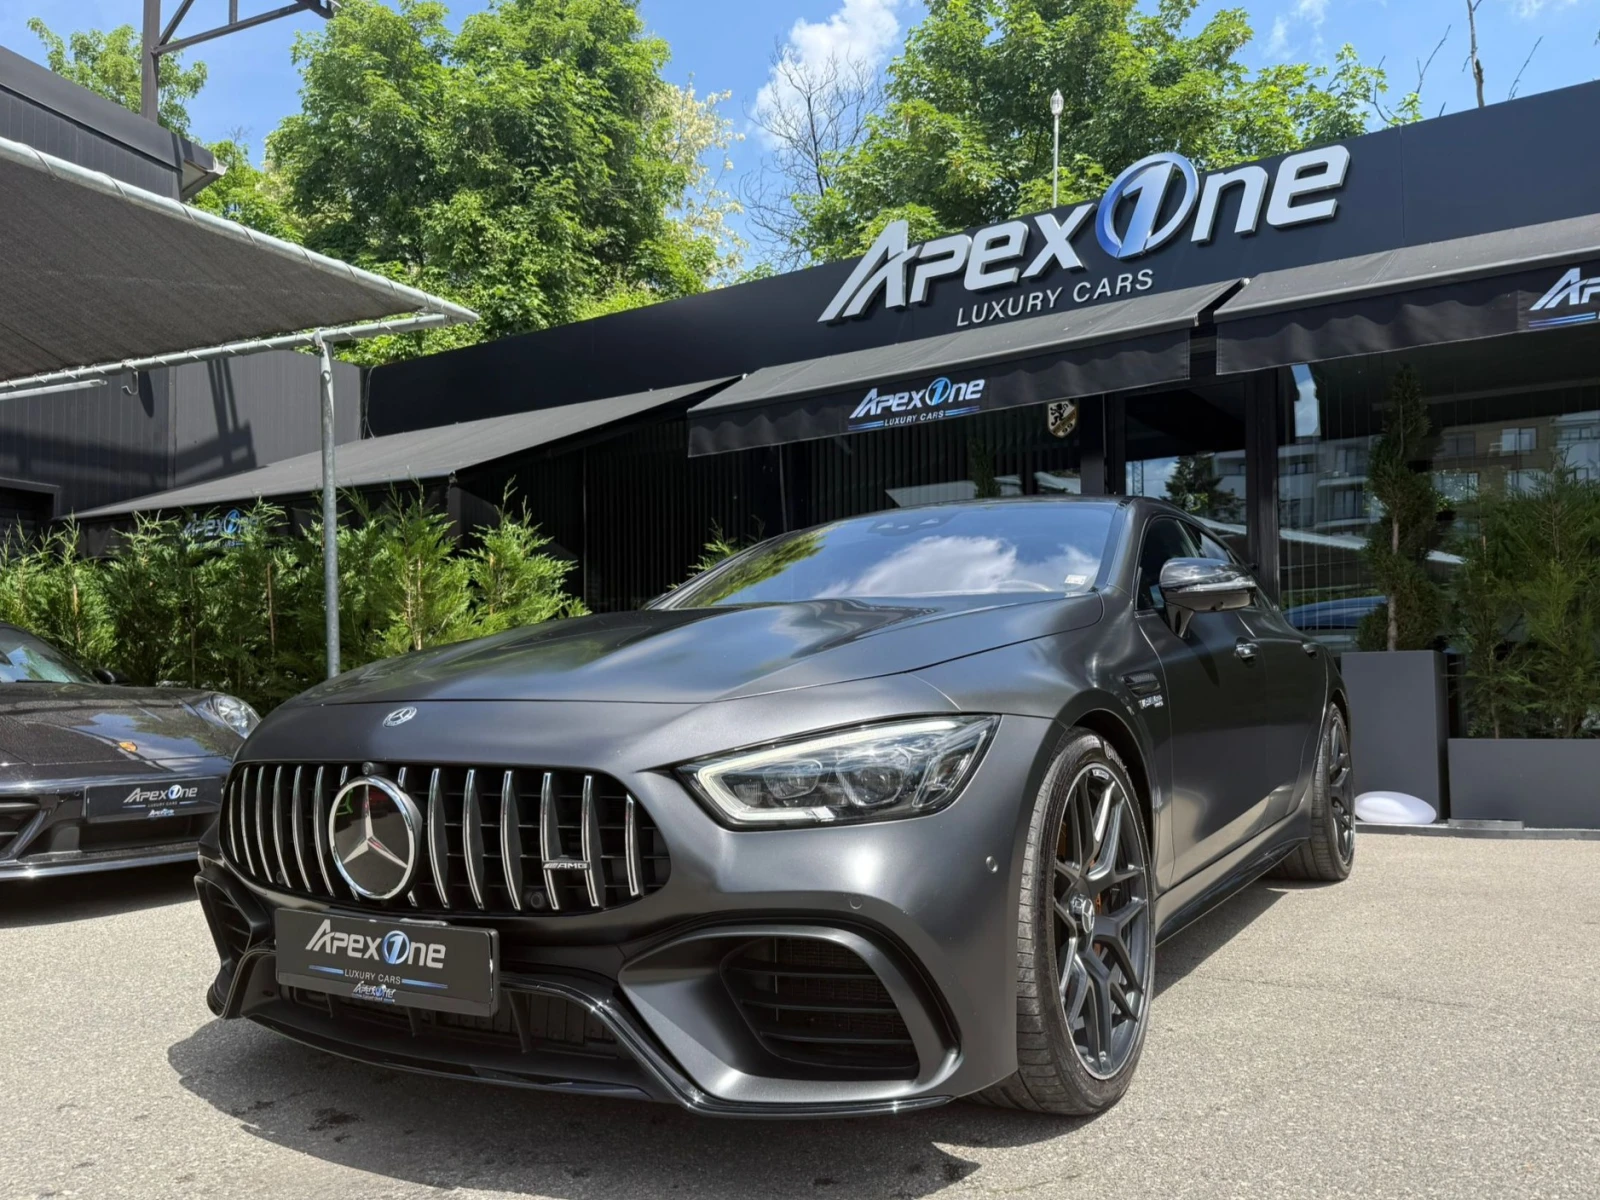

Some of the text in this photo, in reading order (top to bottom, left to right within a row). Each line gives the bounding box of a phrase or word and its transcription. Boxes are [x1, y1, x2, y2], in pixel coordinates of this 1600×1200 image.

[956, 268, 1154, 327] LUXURY CARS
[884, 409, 944, 427] LUXURY CARS
[344, 968, 401, 985] LUXURY CARS
